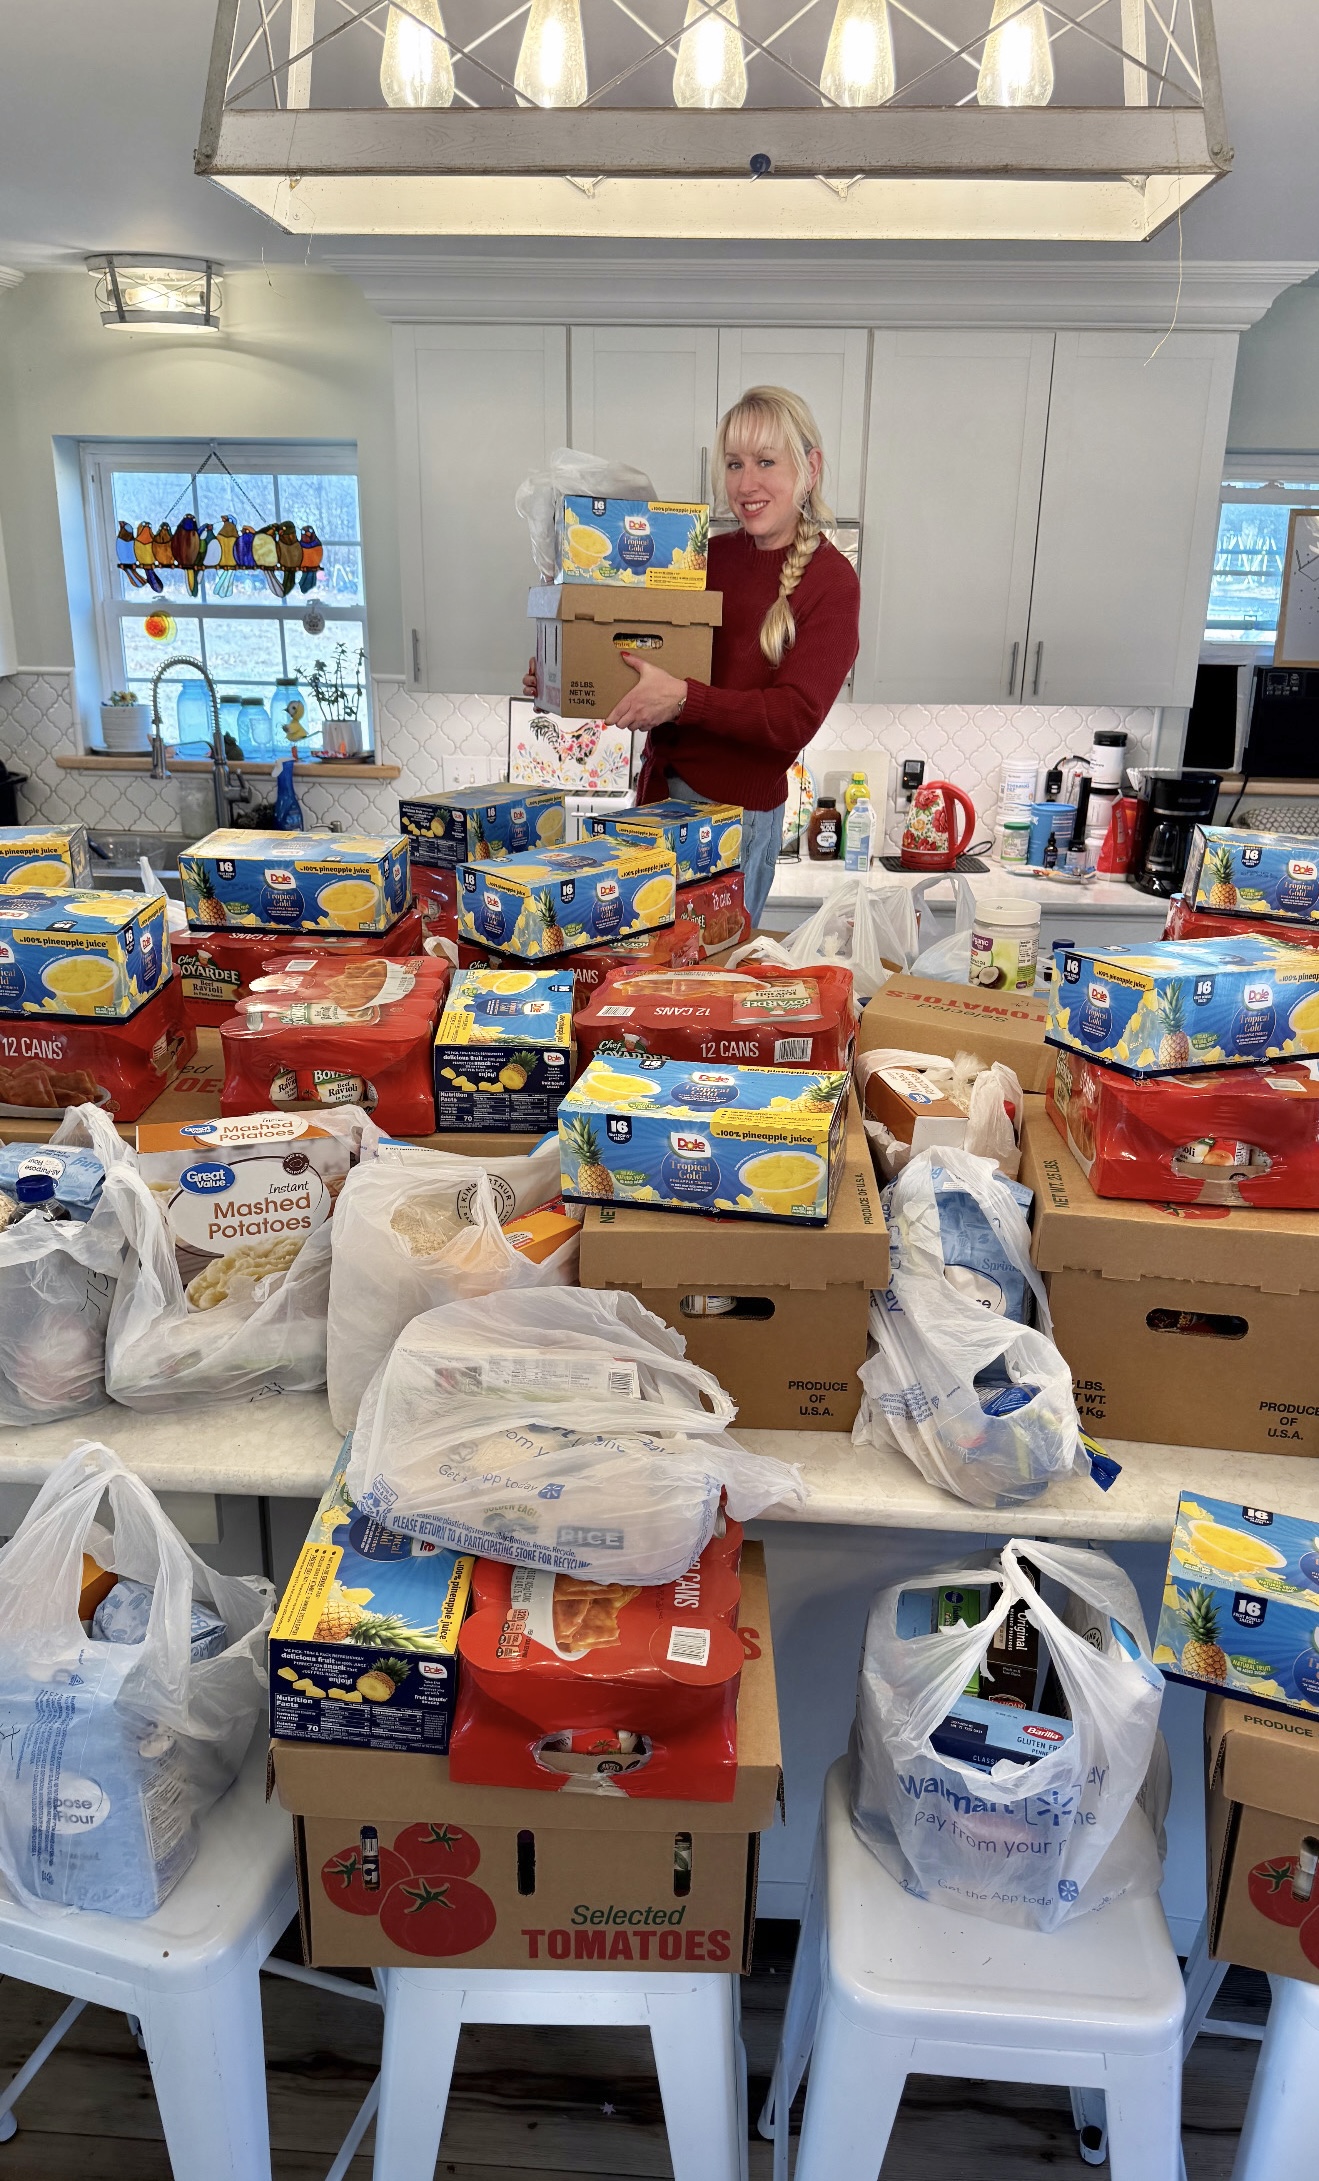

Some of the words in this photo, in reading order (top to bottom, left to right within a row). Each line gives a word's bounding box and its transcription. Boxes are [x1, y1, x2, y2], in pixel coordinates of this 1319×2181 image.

[594, 501, 604, 510] 16
[629, 520, 647, 530] Dole
[628, 544, 644, 552] Gold
[5, 848, 39, 857] pineapple
[40, 847, 58, 855] juice
[1244, 850, 1259, 860] 16
[219, 862, 233, 872] 16
[319, 866, 352, 874] pineapple
[1293, 864, 1313, 873] Dole
[270, 874, 291, 884] Dole
[562, 884, 573, 895] 16
[600, 885, 616, 896] Dole
[266, 892, 297, 901] Tropical
[720, 892, 732, 907] CANS
[43, 938, 84, 948] pineapple
[85, 939, 107, 948] juice
[178, 955, 195, 965] Chef
[469, 961, 488, 970] Chef
[1066, 960, 1079, 973] 16
[1109, 973, 1134, 986] pineapple
[193, 984, 223, 994] Ravioli
[1197, 981, 1211, 994] 16
[1091, 988, 1107, 1002] Dole
[1248, 990, 1269, 1001] Dole
[654, 1007, 692, 1016] CANS
[696, 1008, 711, 1016] 12
[885, 990, 1047, 1023] TOMATOES
[916, 1003, 1009, 1023] Selected
[1239, 1014, 1270, 1026] Tropical
[1244, 1023, 1262, 1032] Gold
[2, 1038, 17, 1057] 12
[22, 1038, 63, 1060] CANS
[599, 1040, 622, 1051] Chef
[701, 1042, 717, 1058] 12
[720, 1041, 759, 1058] CANS
[699, 1074, 730, 1083] Dole
[328, 1083, 358, 1097] Ravioli
[337, 1081, 350, 1089] Beef
[685, 1085, 730, 1094] Tropical
[223, 1121, 293, 1133] Mashed
[610, 1121, 629, 1133] 16
[219, 1130, 295, 1142] Potatoes
[720, 1130, 741, 1140] 100%
[742, 1132, 788, 1143] pineapple
[788, 1134, 813, 1145] juice
[677, 1138, 706, 1149] Dole
[670, 1160, 711, 1173] Tropical
[186, 1169, 226, 1183] Great
[678, 1170, 702, 1180] Gold
[197, 1179, 226, 1188] Value
[268, 1181, 310, 1195] Instant
[461, 1183, 478, 1203] KING
[489, 1178, 512, 1201] RTHUR
[858, 1188, 867, 1196] OF
[213, 1192, 311, 1220] Mashed
[1052, 1194, 1070, 1208] NET
[600, 1205, 616, 1224] NET
[860, 1197, 874, 1225] PRODUCE
[208, 1215, 312, 1240] Potatoes
[788, 1380, 848, 1392] PRODUCE
[1076, 1380, 1105, 1392] LBS.
[809, 1394, 826, 1403] OF
[1084, 1394, 1106, 1405] WT.
[799, 1405, 834, 1416] U.S.A.
[1086, 1407, 1106, 1419] Kg.
[1259, 1401, 1319, 1416] PRODUCE
[1279, 1416, 1299, 1427] OF
[1267, 1428, 1304, 1441] U.S.A.
[439, 1464, 461, 1483] Get
[505, 1475, 539, 1492] today
[1247, 1508, 1269, 1520] 16
[393, 1515, 418, 1533] PLEASE
[419, 1520, 446, 1540] RETURN
[457, 1532, 463, 1544] A
[464, 1532, 514, 1557] PARTICIPATING
[515, 1549, 537, 1563] STORE
[537, 1551, 553, 1566] FOR
[443, 1517, 462, 1528] plastic
[552, 1545, 576, 1558] Recycle.
[560, 1530, 620, 1546] RICE
[454, 1563, 465, 1581] 100%
[674, 1571, 701, 1609] CANS
[444, 1580, 462, 1619] pineapple
[1238, 1599, 1262, 1617] 16
[440, 1619, 453, 1641] juice
[1014, 1612, 1028, 1651] Original
[281, 1653, 317, 1663] delicious
[317, 1656, 335, 1664] fruit
[424, 1665, 443, 1675] Dole
[1233, 1660, 1256, 1671] NATURAL
[328, 1677, 353, 1685] enjoy!
[276, 1694, 313, 1704] Nutrition
[276, 1701, 299, 1709] Facts
[306, 1724, 319, 1732] 70
[1243, 1714, 1314, 1738] PRODUCE
[1027, 1726, 1062, 1740] Barilla
[1017, 1737, 1047, 1750] GLUTEN
[1032, 1748, 1049, 1757] PENNE
[897, 1773, 1015, 1815] Walmart
[57, 1811, 95, 1826] Flour
[914, 1811, 947, 1832] pay
[952, 1821, 997, 1853] from
[1004, 1841, 1052, 1859] your
[937, 1878, 964, 1892] Get
[966, 1889, 988, 1901] the
[993, 1892, 1019, 1906] App
[1023, 1894, 1054, 1906] toda
[570, 1904, 687, 1926] Selected
[521, 1929, 731, 1962] TOMATOES
